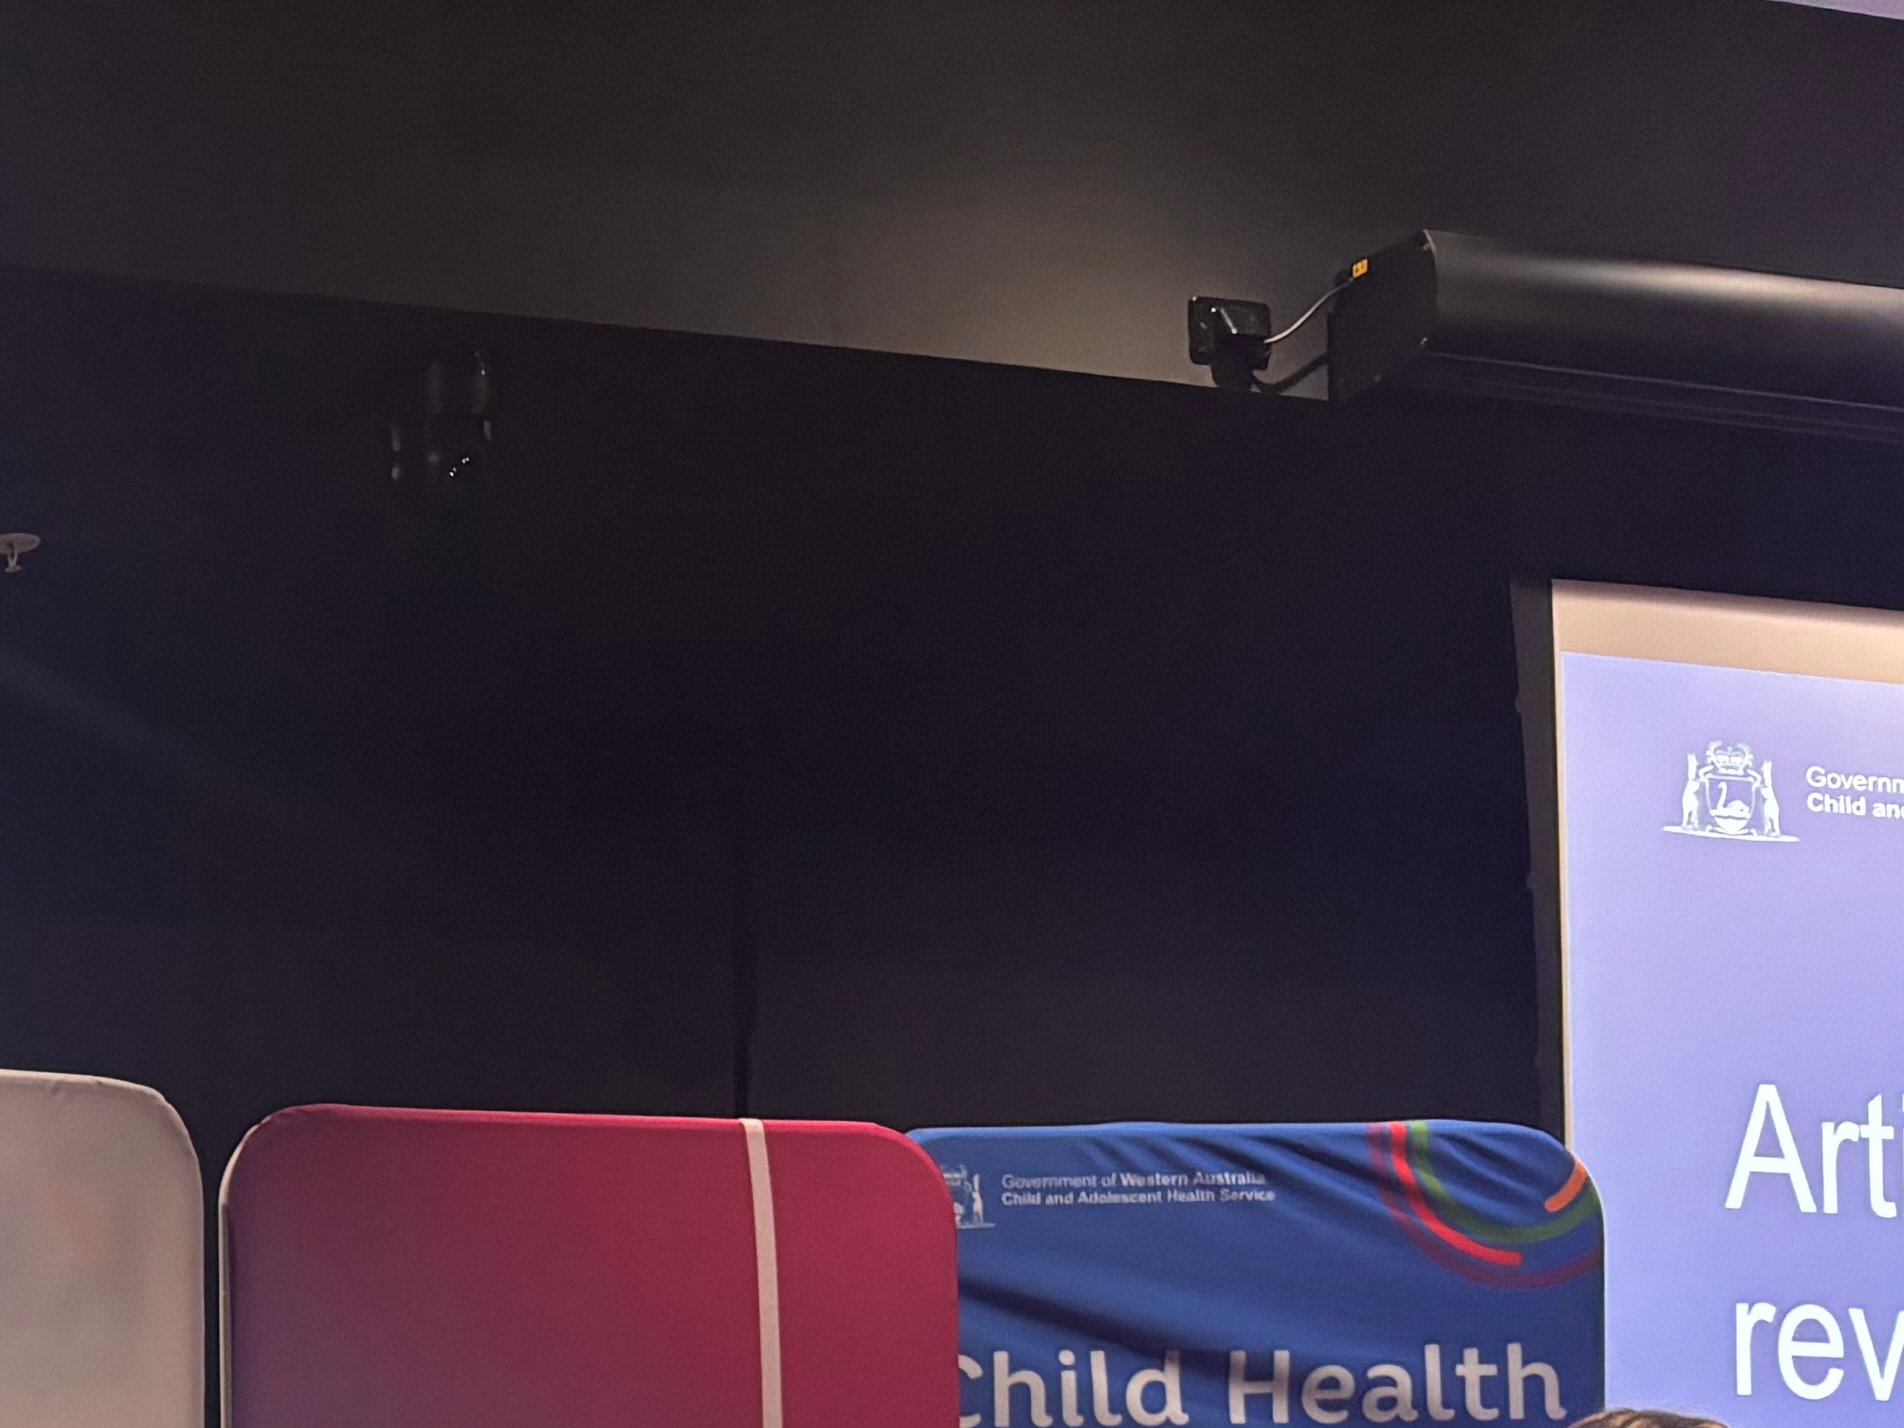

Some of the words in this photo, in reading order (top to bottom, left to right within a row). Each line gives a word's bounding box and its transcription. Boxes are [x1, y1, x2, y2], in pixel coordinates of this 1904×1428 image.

[1807, 792, 1866, 815] Child
[1872, 802, 1904, 819] an
[1725, 1083, 1904, 1218] Art
[1001, 1174, 1096, 1188] Government
[1101, 1172, 1116, 1187] of
[1120, 1173, 1188, 1186] Western
[1194, 1171, 1265, 1185] Australia
[1001, 1190, 1041, 1206] Child
[1046, 1191, 1073, 1205] and
[1168, 1189, 1215, 1202] Health
[1219, 1188, 1275, 1202] Service
[1228, 1342, 1566, 1425] Health
